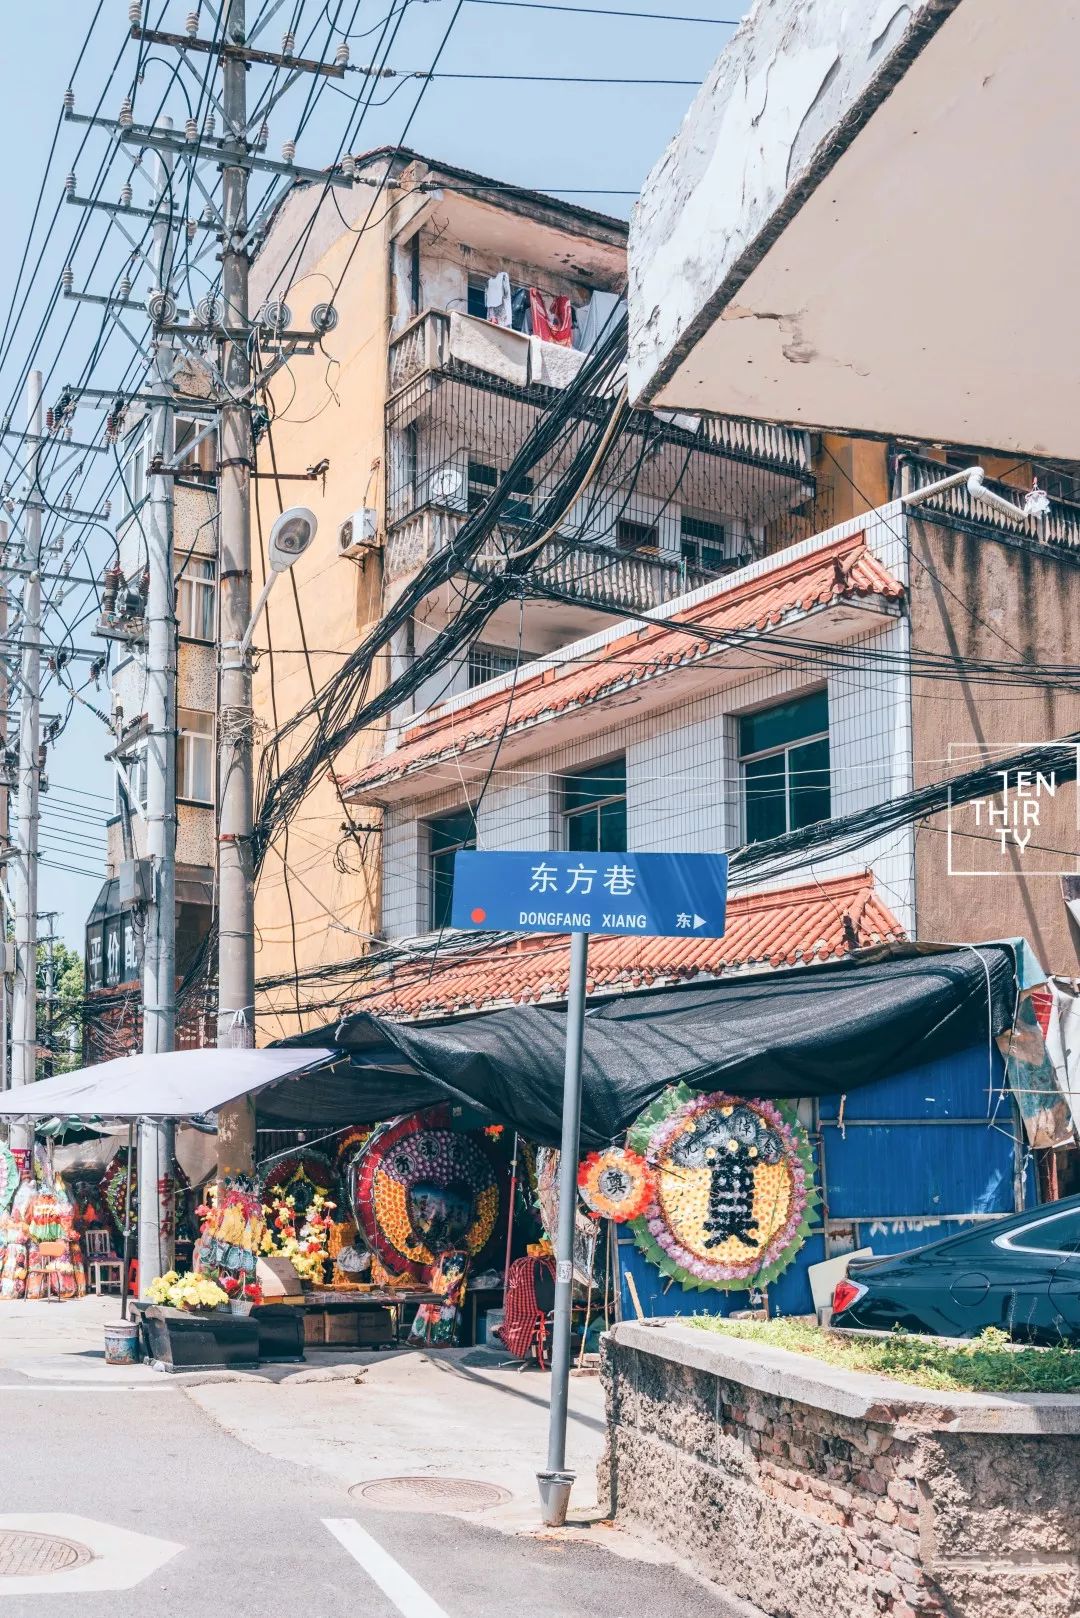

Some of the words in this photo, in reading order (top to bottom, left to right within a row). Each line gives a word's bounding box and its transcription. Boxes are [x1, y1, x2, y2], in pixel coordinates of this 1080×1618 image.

[528, 861, 637, 896] 东方巷
[518, 911, 591, 928] DONGFANG
[601, 914, 647, 929] XIANG
[675, 912, 692, 929] 东
